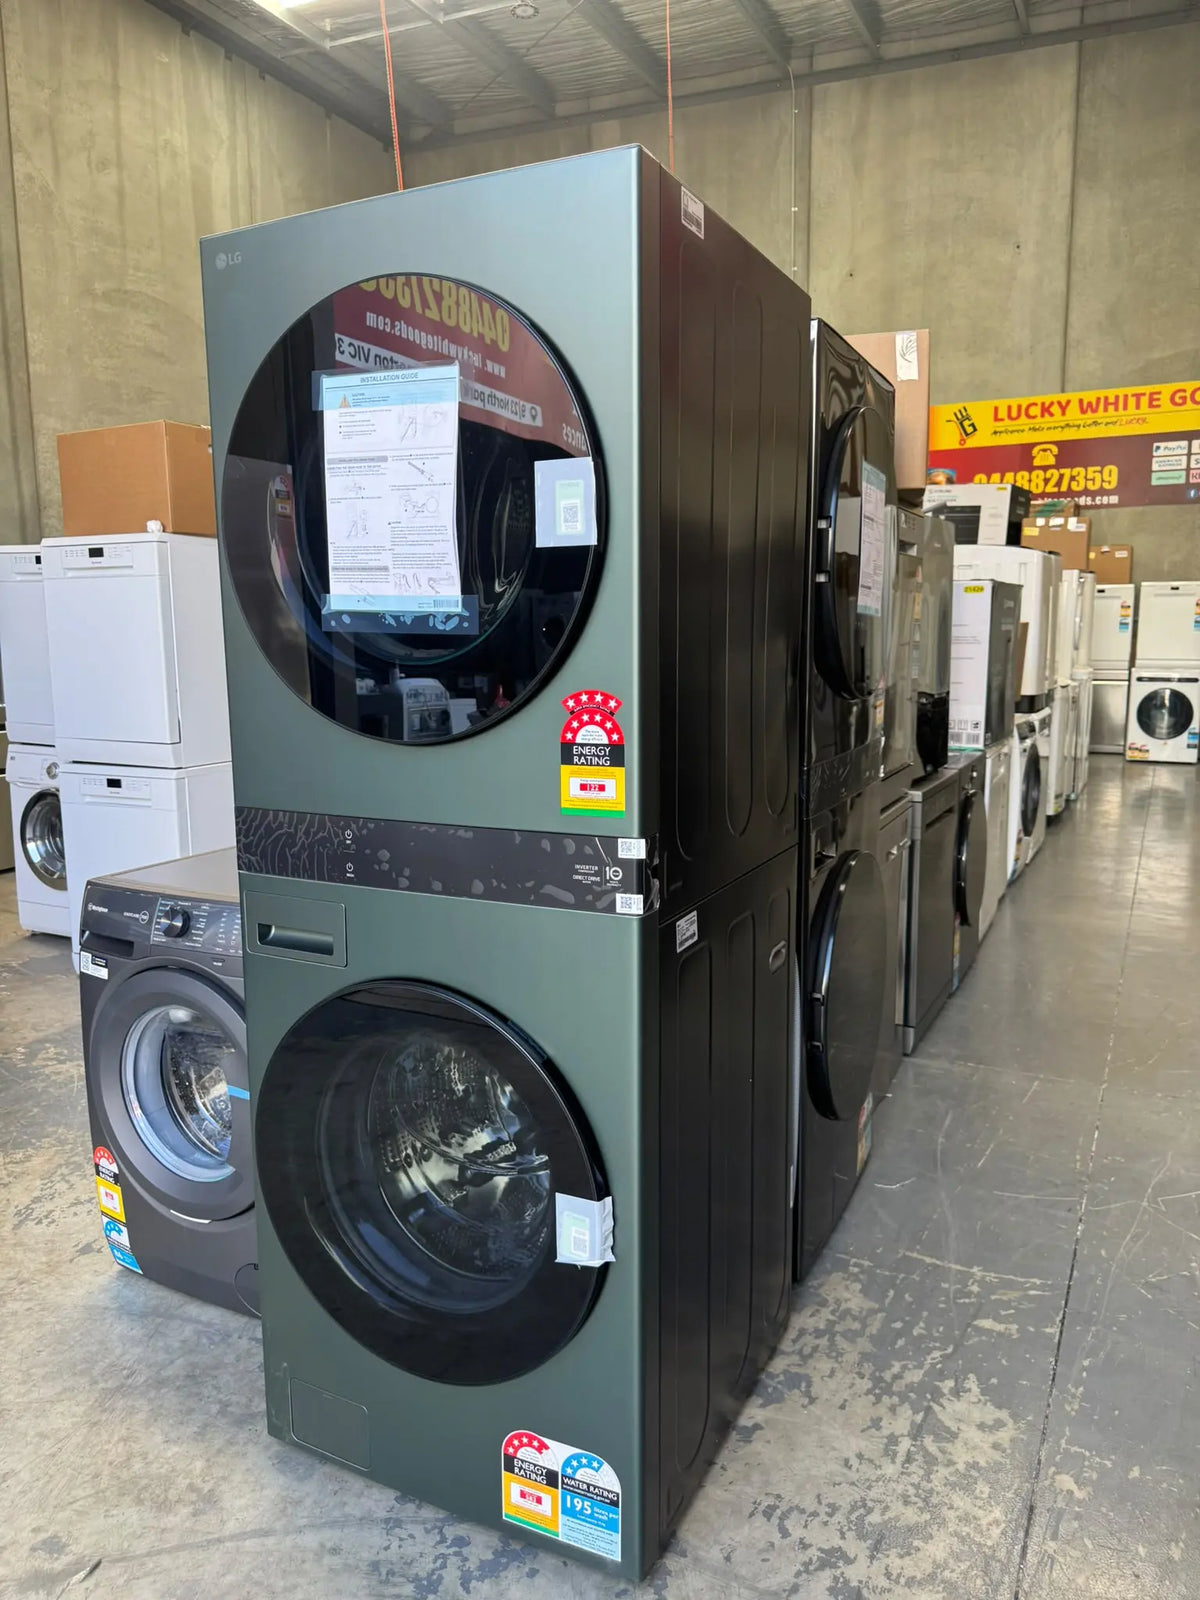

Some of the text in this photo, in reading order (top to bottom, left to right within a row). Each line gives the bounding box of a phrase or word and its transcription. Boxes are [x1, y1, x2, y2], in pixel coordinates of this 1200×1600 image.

[228, 251, 242, 265] LG
[360, 374, 399, 383] INSTALLATION
[993, 399, 1071, 423] LUCKY
[1077, 391, 1162, 415] WHITE
[573, 745, 611, 756] ENERGY
[573, 756, 611, 766] RATING
[574, 863, 599, 871] INVERTER
[605, 866, 623, 881] 10
[513, 1458, 548, 1476] ENERGY
[514, 1466, 547, 1485] RATING
[562, 1476, 588, 1492] WATER
[589, 1485, 618, 1501] RATING
[566, 1494, 592, 1515] 195
